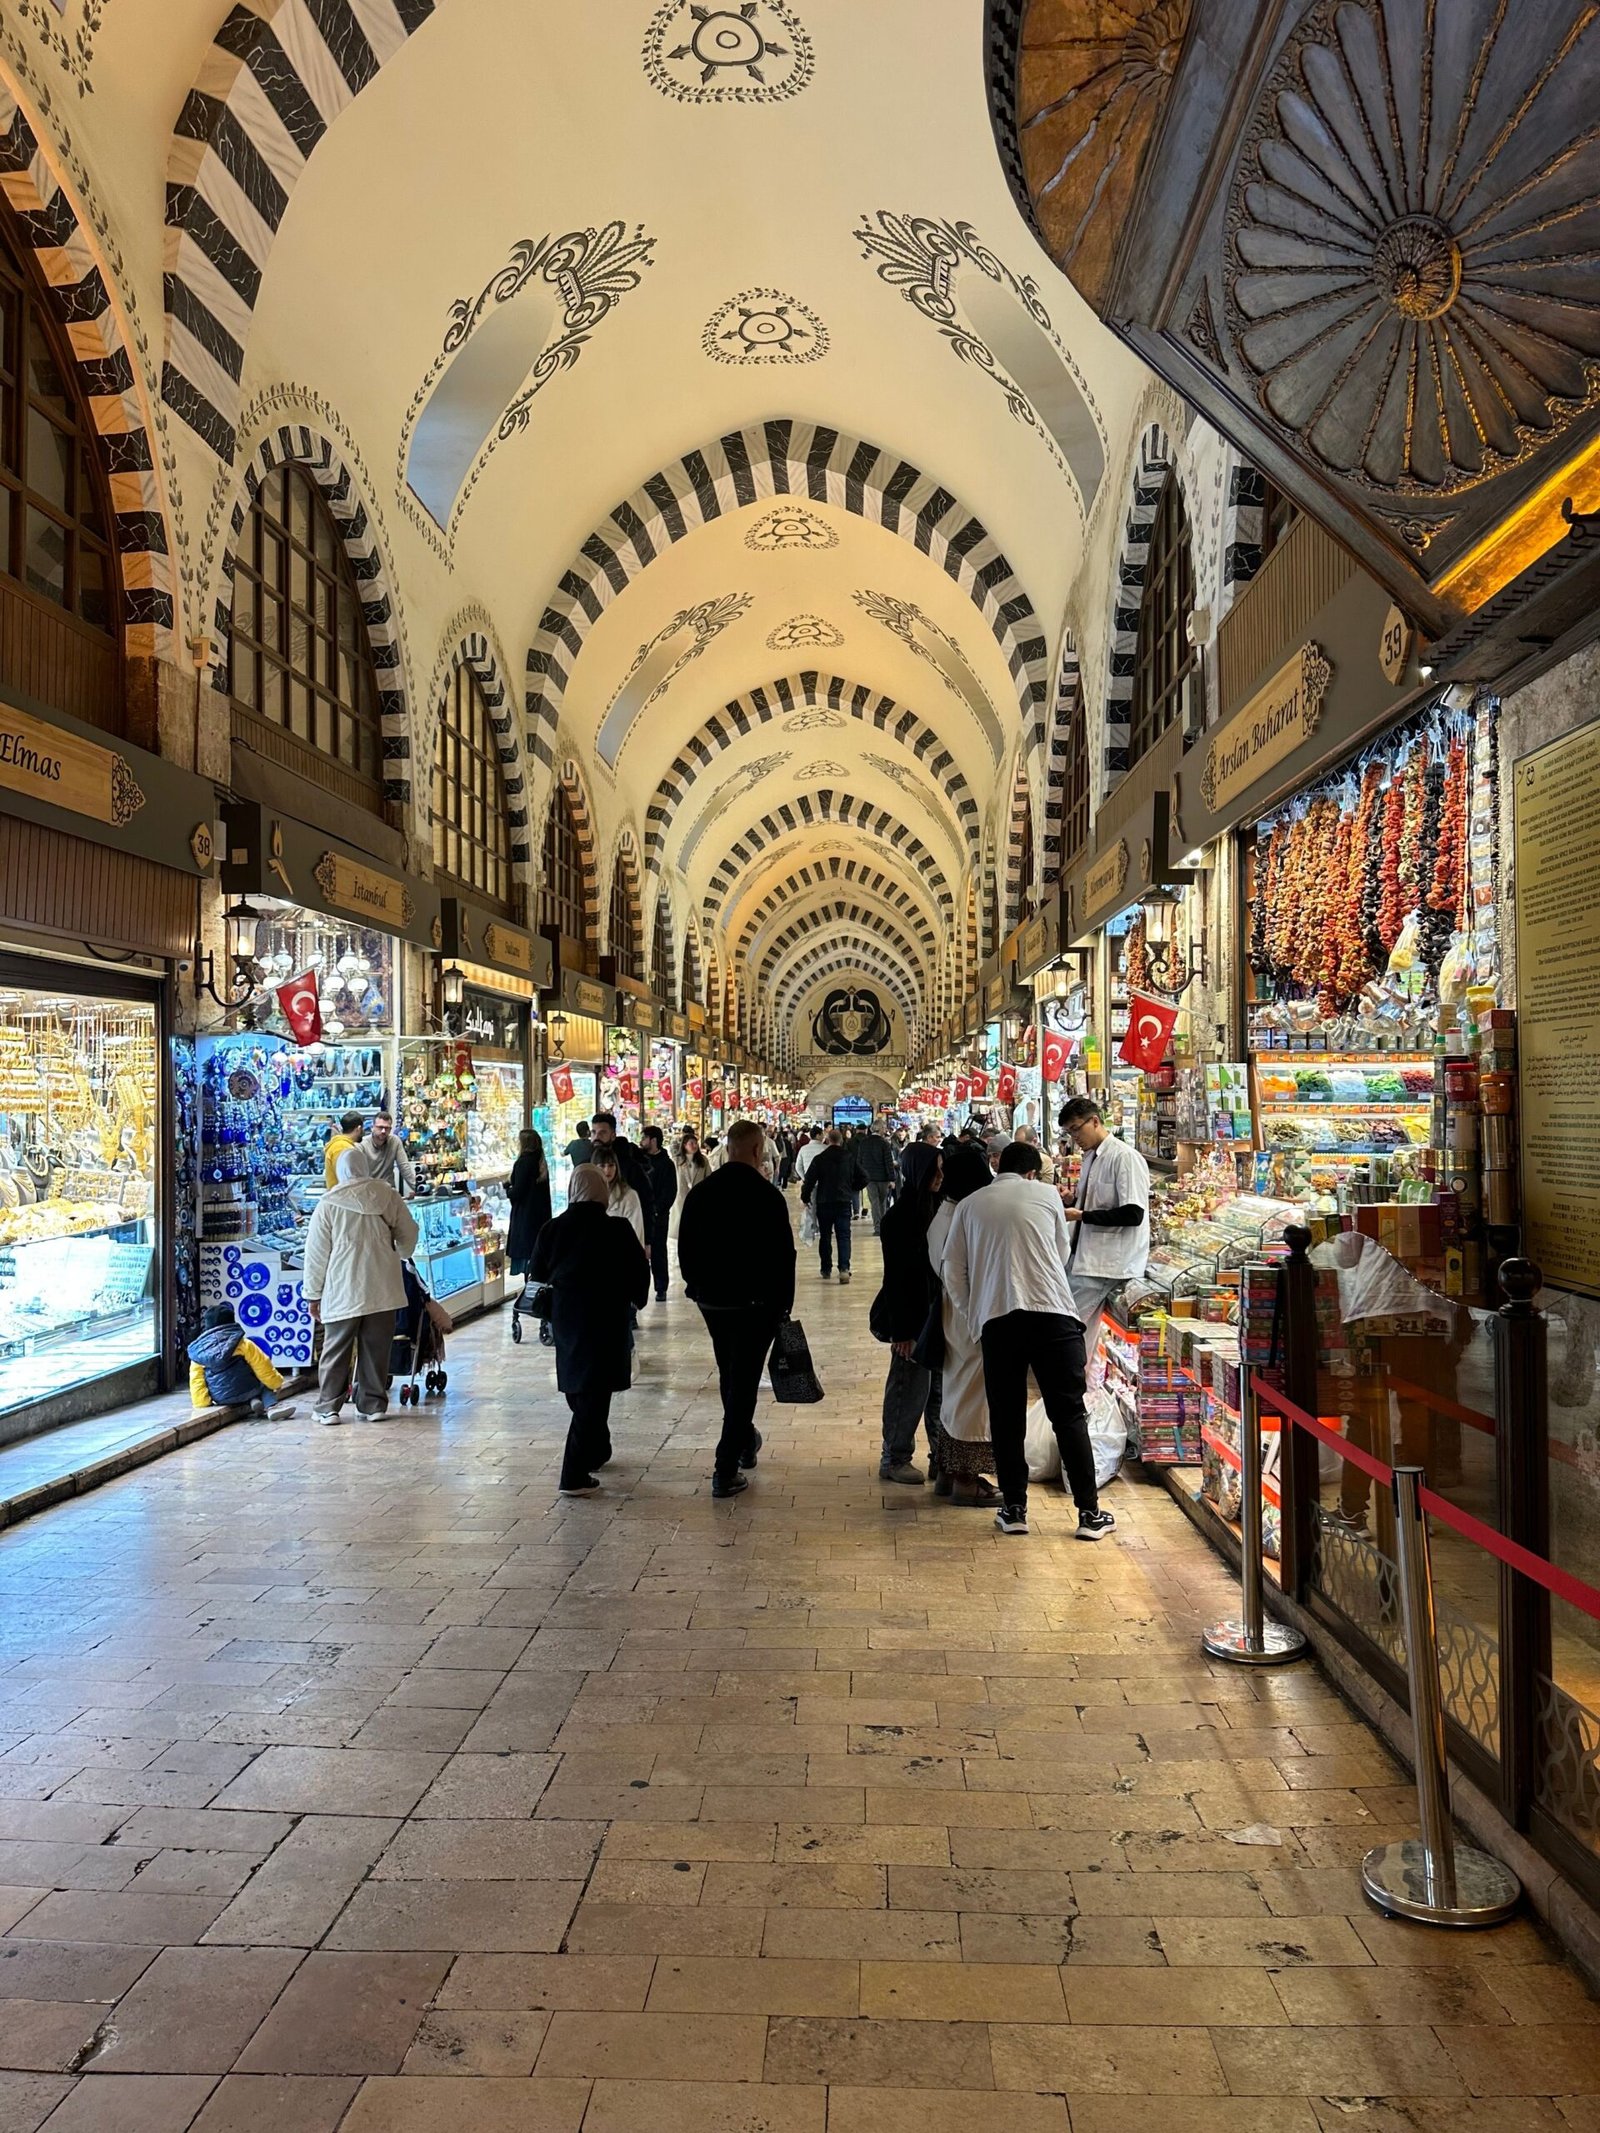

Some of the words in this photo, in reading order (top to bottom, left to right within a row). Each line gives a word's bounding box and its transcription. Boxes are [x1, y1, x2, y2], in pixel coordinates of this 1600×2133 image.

[1385, 623, 1402, 667] 39
[0, 732, 62, 781] Elmas
[1218, 736, 1250, 785] Arslan
[1251, 687, 1300, 756] Baharat
[197, 835, 210, 857] 38
[353, 875, 387, 909] İstanbul
